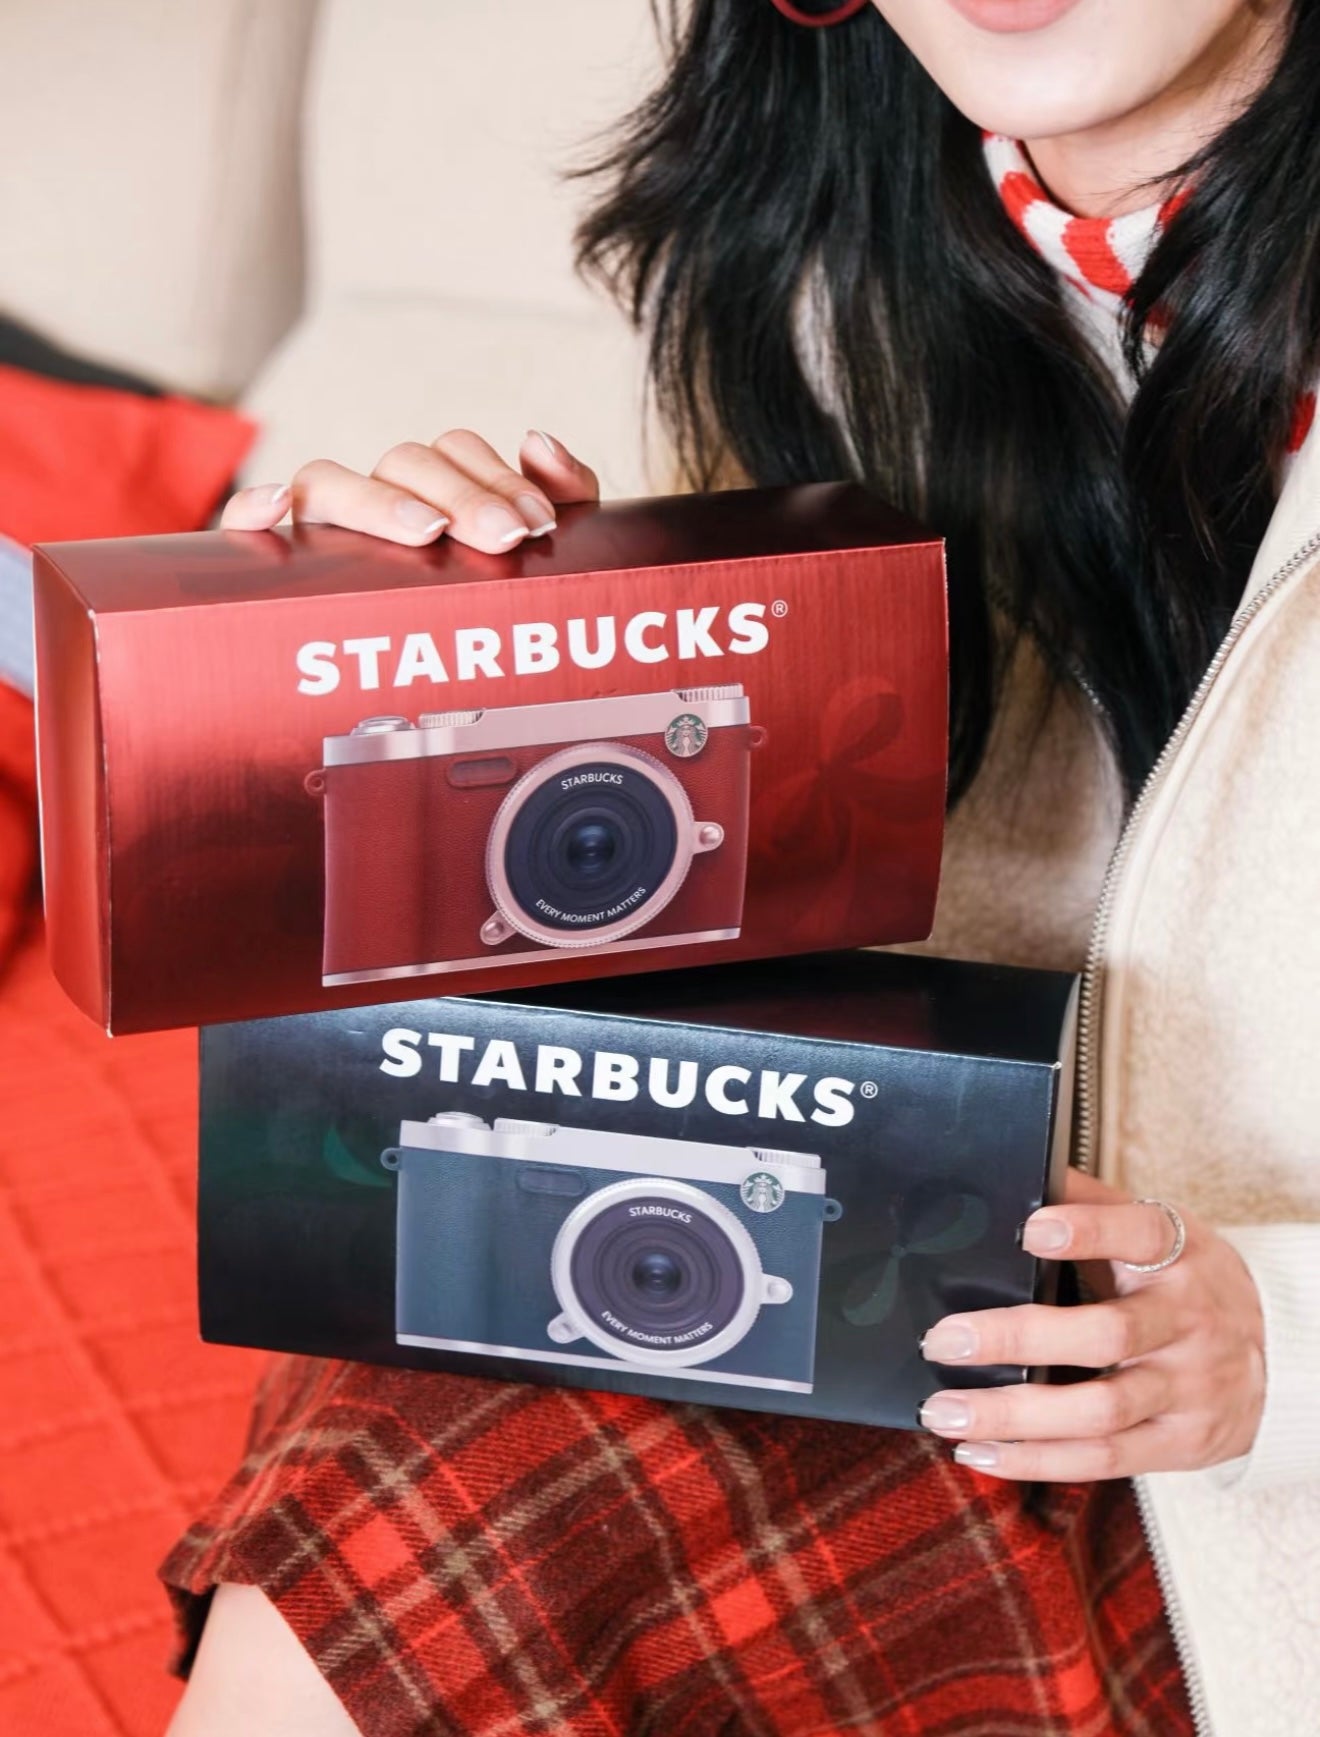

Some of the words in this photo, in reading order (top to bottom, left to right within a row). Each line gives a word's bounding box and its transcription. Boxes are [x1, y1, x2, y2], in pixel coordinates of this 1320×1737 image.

[561, 772, 624, 790] STARBUCKS
[535, 899, 562, 918] EVERY
[560, 911, 605, 923] MOMENT
[607, 886, 647, 917] MATTERS
[628, 1206, 692, 1224] STARBUCKS
[601, 1310, 628, 1332] EVERY
[627, 1329, 673, 1345] MOMENT
[673, 1321, 714, 1343] MATTERS
